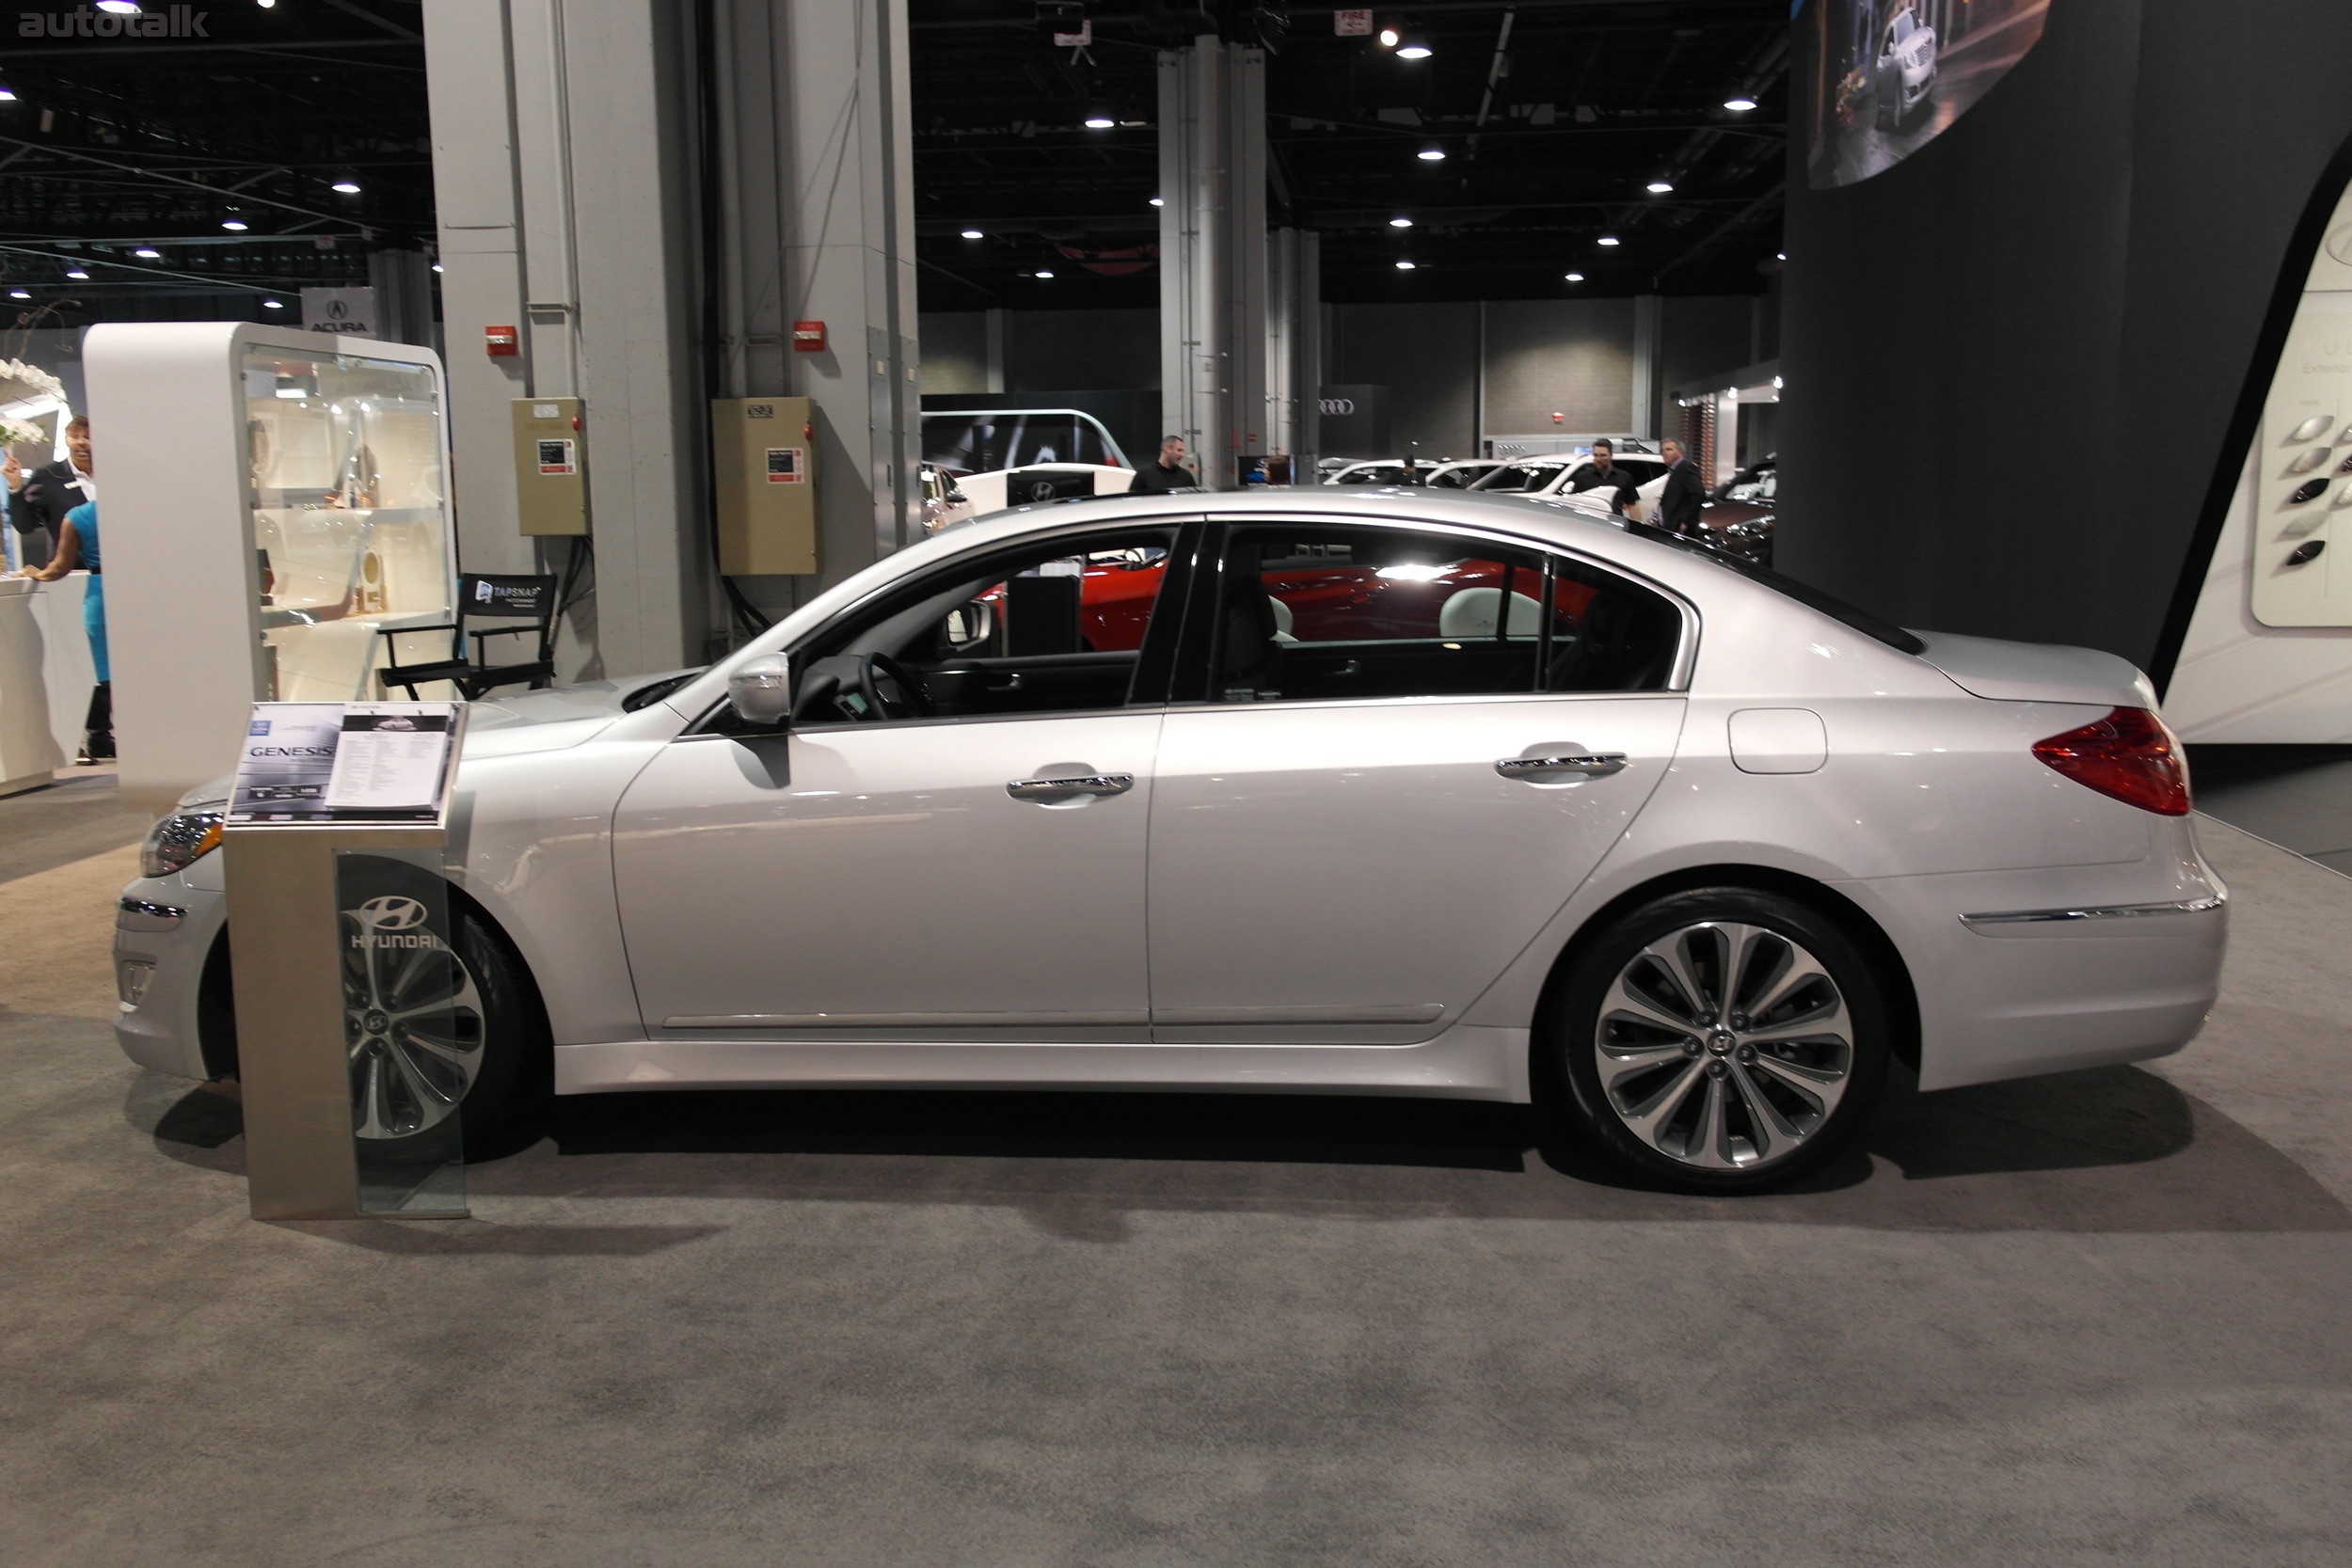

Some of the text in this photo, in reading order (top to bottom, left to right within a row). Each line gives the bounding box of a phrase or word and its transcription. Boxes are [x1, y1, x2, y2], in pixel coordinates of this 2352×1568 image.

[311, 323, 368, 333] ACURA
[249, 745, 337, 757] GENESIS
[351, 934, 437, 949] HYUNDAI
